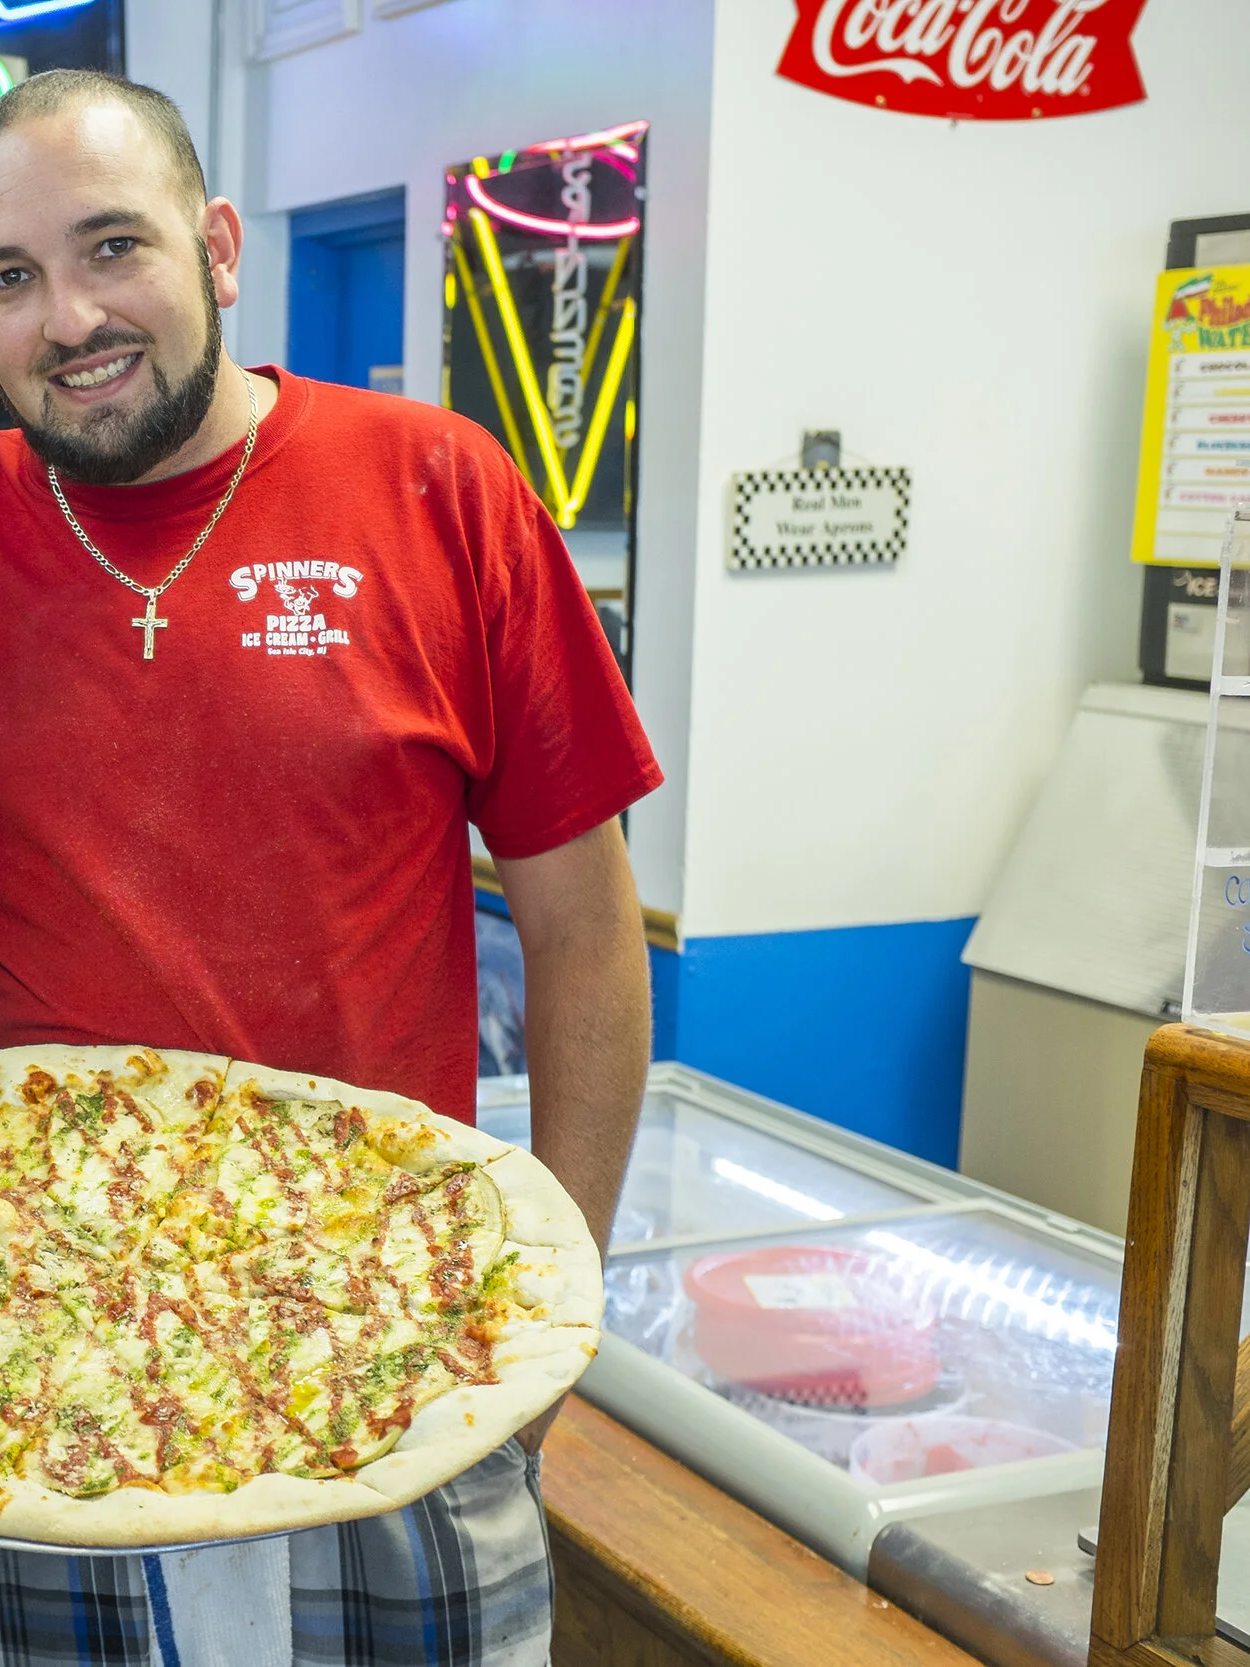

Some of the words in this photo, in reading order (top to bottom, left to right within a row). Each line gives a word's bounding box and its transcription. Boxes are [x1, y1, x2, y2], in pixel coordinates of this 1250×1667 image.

[792, 497, 825, 511] Real
[830, 496, 862, 509] Men
[776, 521, 815, 535] Wear
[824, 521, 874, 537] Aprons
[228, 560, 364, 602] SPINNERS
[266, 613, 327, 632] PIZZA
[241, 632, 261, 648] ICE
[265, 631, 309, 647] CREAM
[318, 629, 350, 645] GRILL
[267, 647, 281, 656] Sea
[282, 647, 297, 655] Isle
